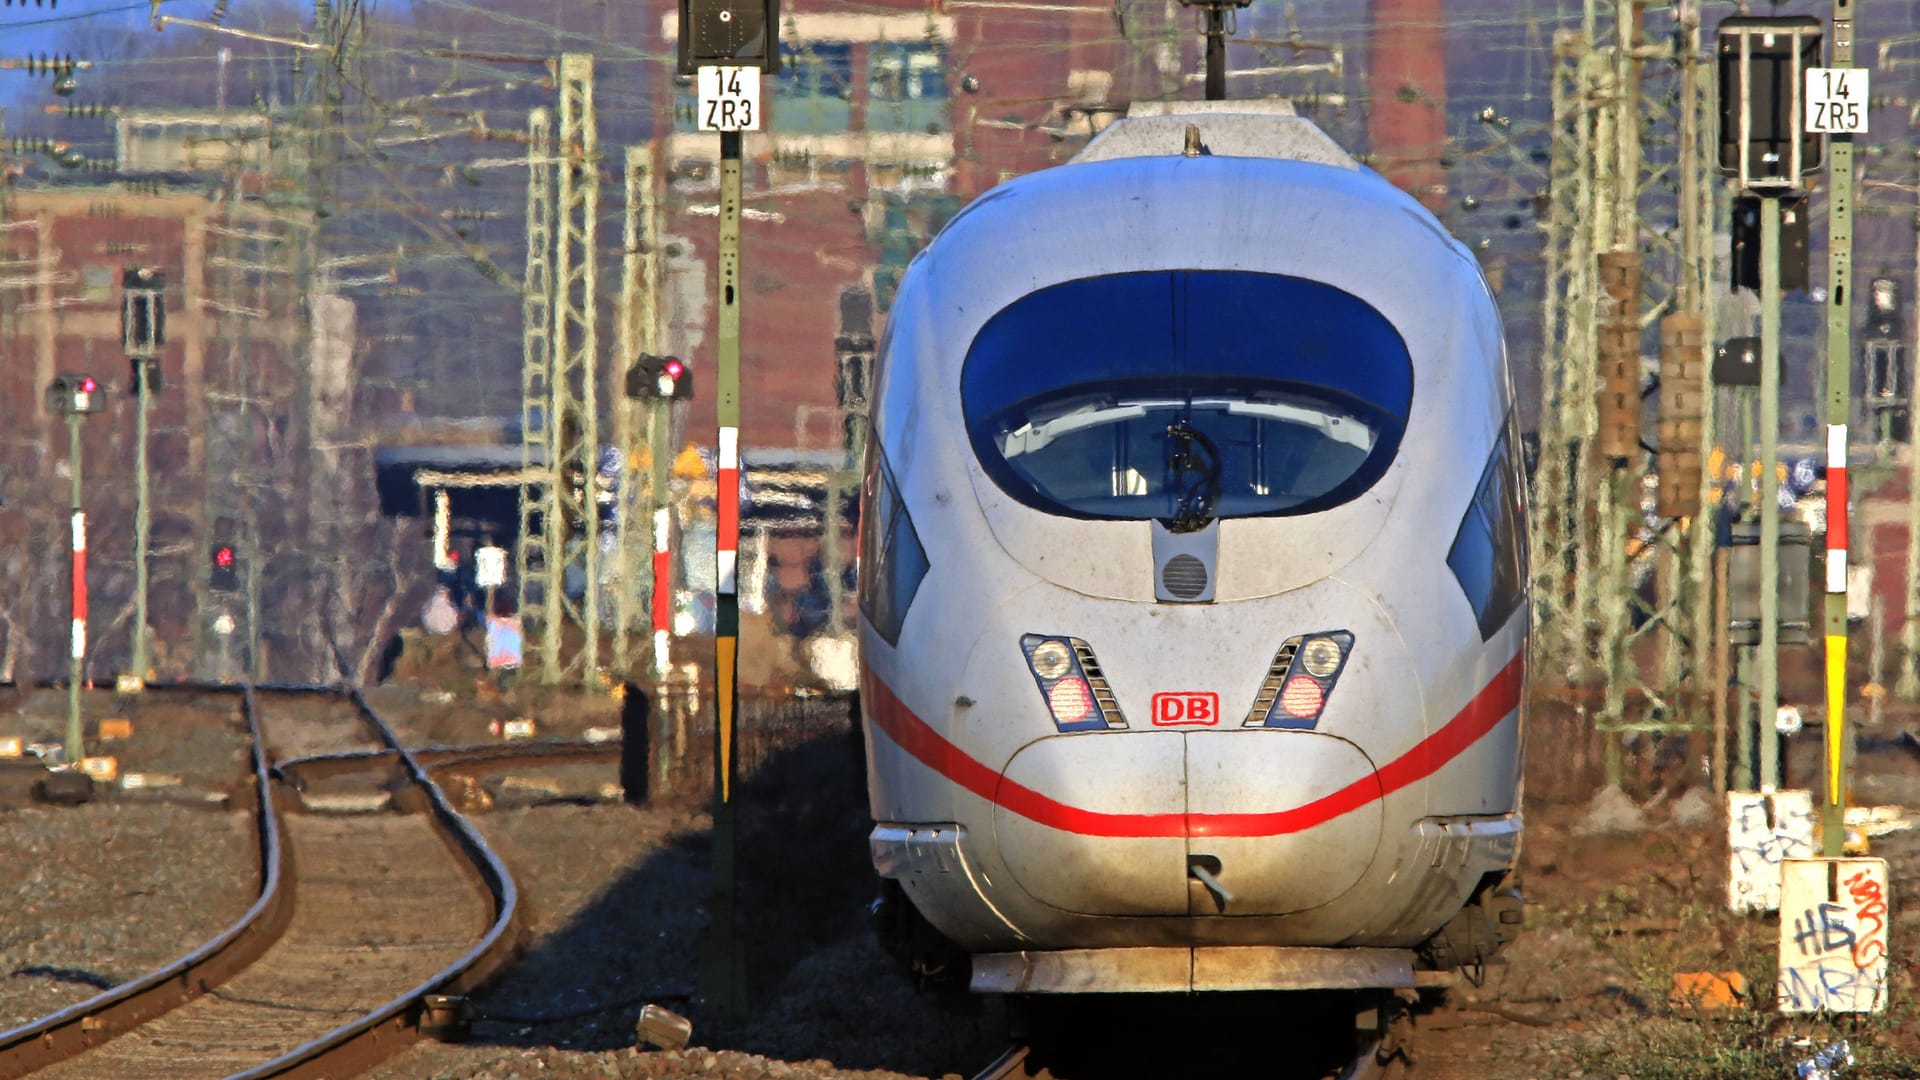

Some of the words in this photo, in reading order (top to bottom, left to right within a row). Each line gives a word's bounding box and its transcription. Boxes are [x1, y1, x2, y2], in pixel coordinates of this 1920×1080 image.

[716, 69, 741, 96] 14
[1822, 72, 1849, 99] 14
[707, 99, 751, 128] ZR3
[1814, 102, 1859, 129] ZR5
[1161, 697, 1211, 721] DB
